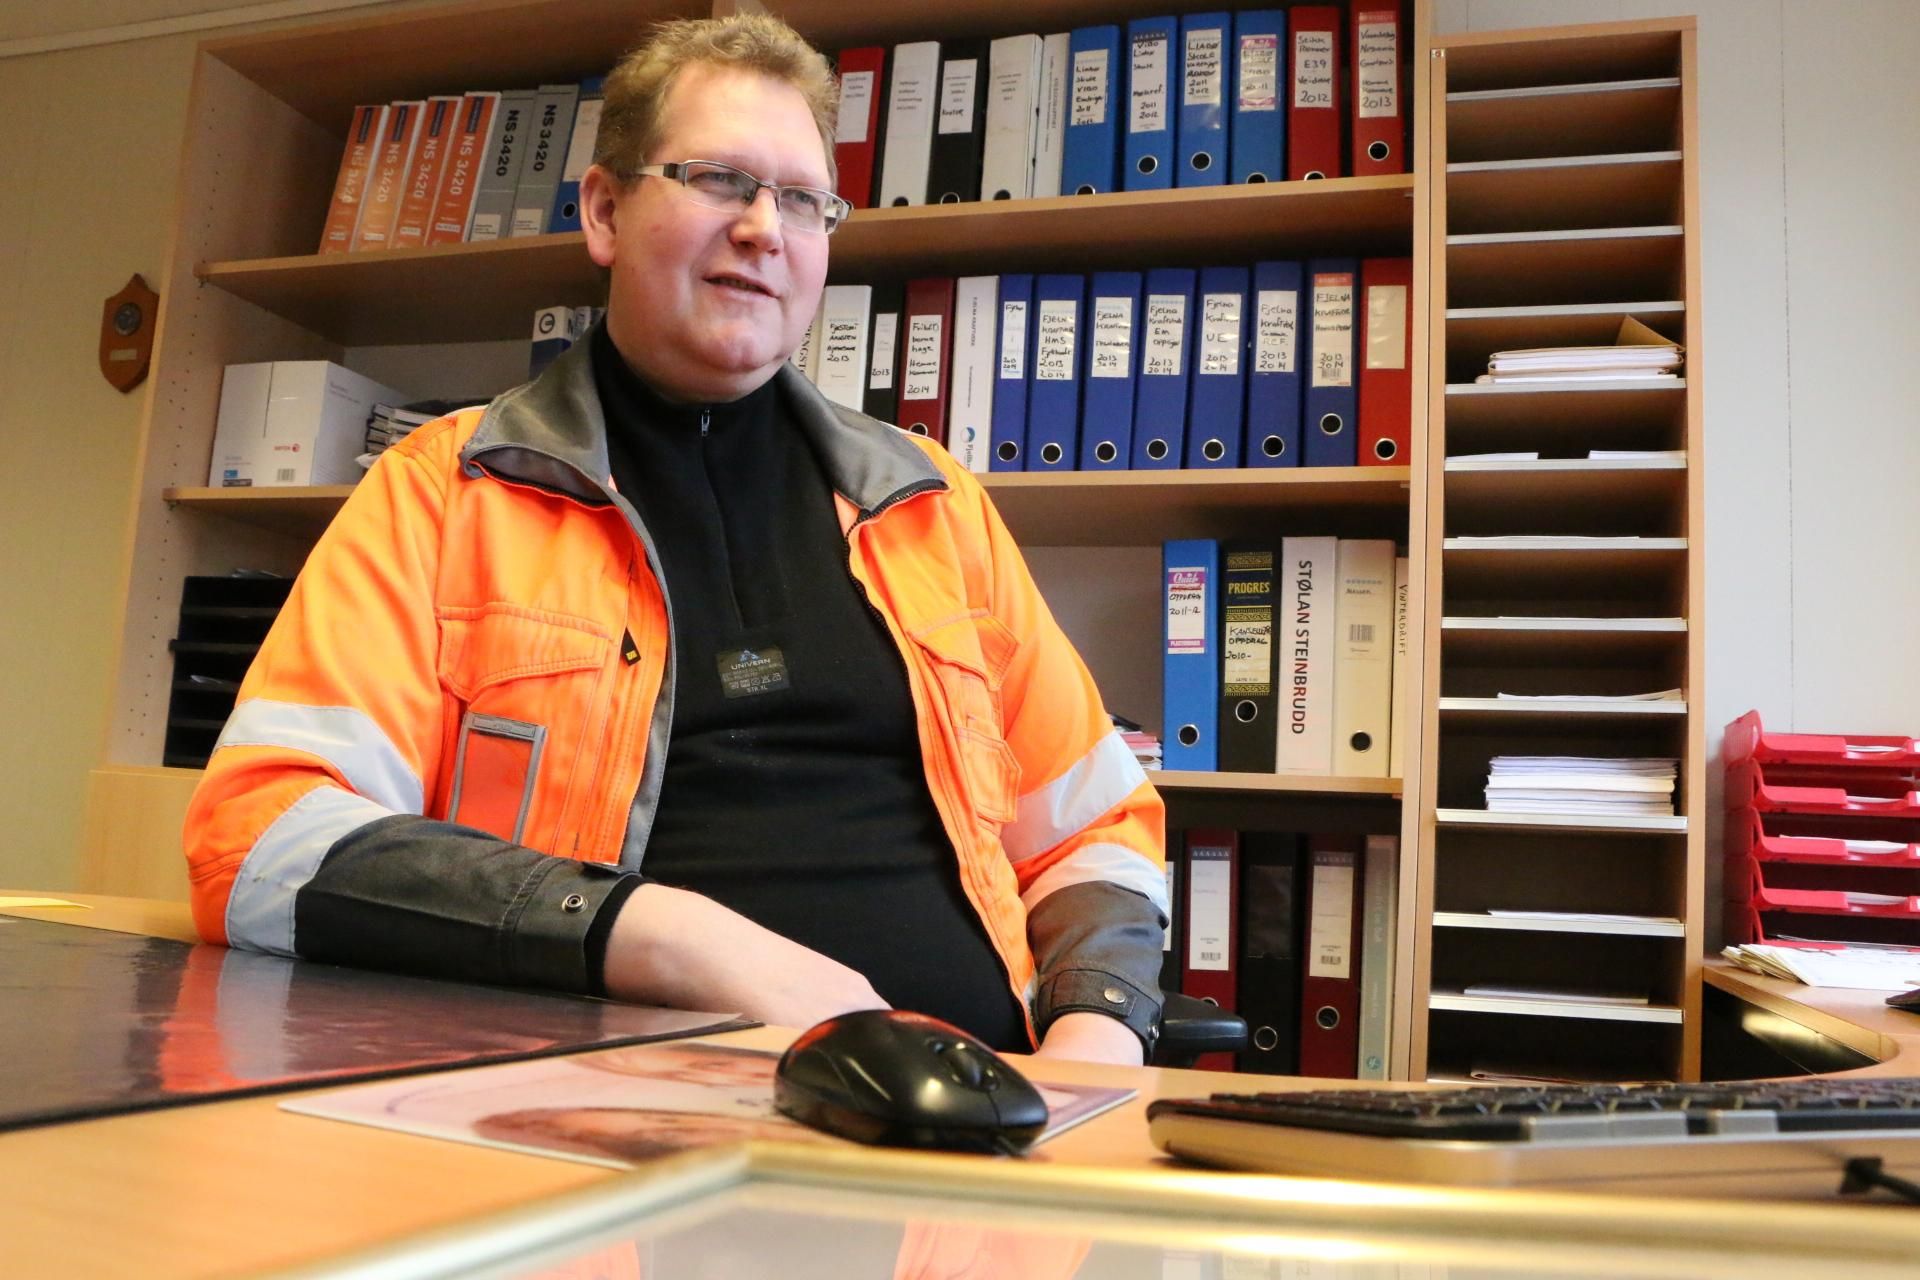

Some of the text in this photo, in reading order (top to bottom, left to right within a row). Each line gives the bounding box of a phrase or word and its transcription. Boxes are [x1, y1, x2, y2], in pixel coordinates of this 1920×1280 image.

[1304, 59, 1327, 68] E39
[1300, 91, 1330, 103] 2012
[1362, 97, 1392, 108] 2013
[533, 105, 557, 171] NS 3420
[496, 110, 520, 177] NS 3420
[413, 139, 438, 198] NS 3420
[450, 136, 475, 195] NS 3420
[377, 144, 400, 202] NS 3420
[1261, 351, 1287, 359] 2013
[1320, 353, 1342, 361] 2013
[1039, 358, 1064, 367] 2013
[1149, 357, 1173, 366] 2013
[1260, 361, 1286, 369] 2014
[1317, 361, 1343, 369] 2014
[872, 368, 889, 376] 2013
[1040, 370, 1065, 378] 2014
[1148, 367, 1172, 375] 2014
[907, 385, 930, 394] 2014
[1228, 582, 1271, 594] PROGRES
[1229, 637, 1268, 645] OPPDRAG
[1291, 560, 1313, 734] STØLAN STEINBRUDD
